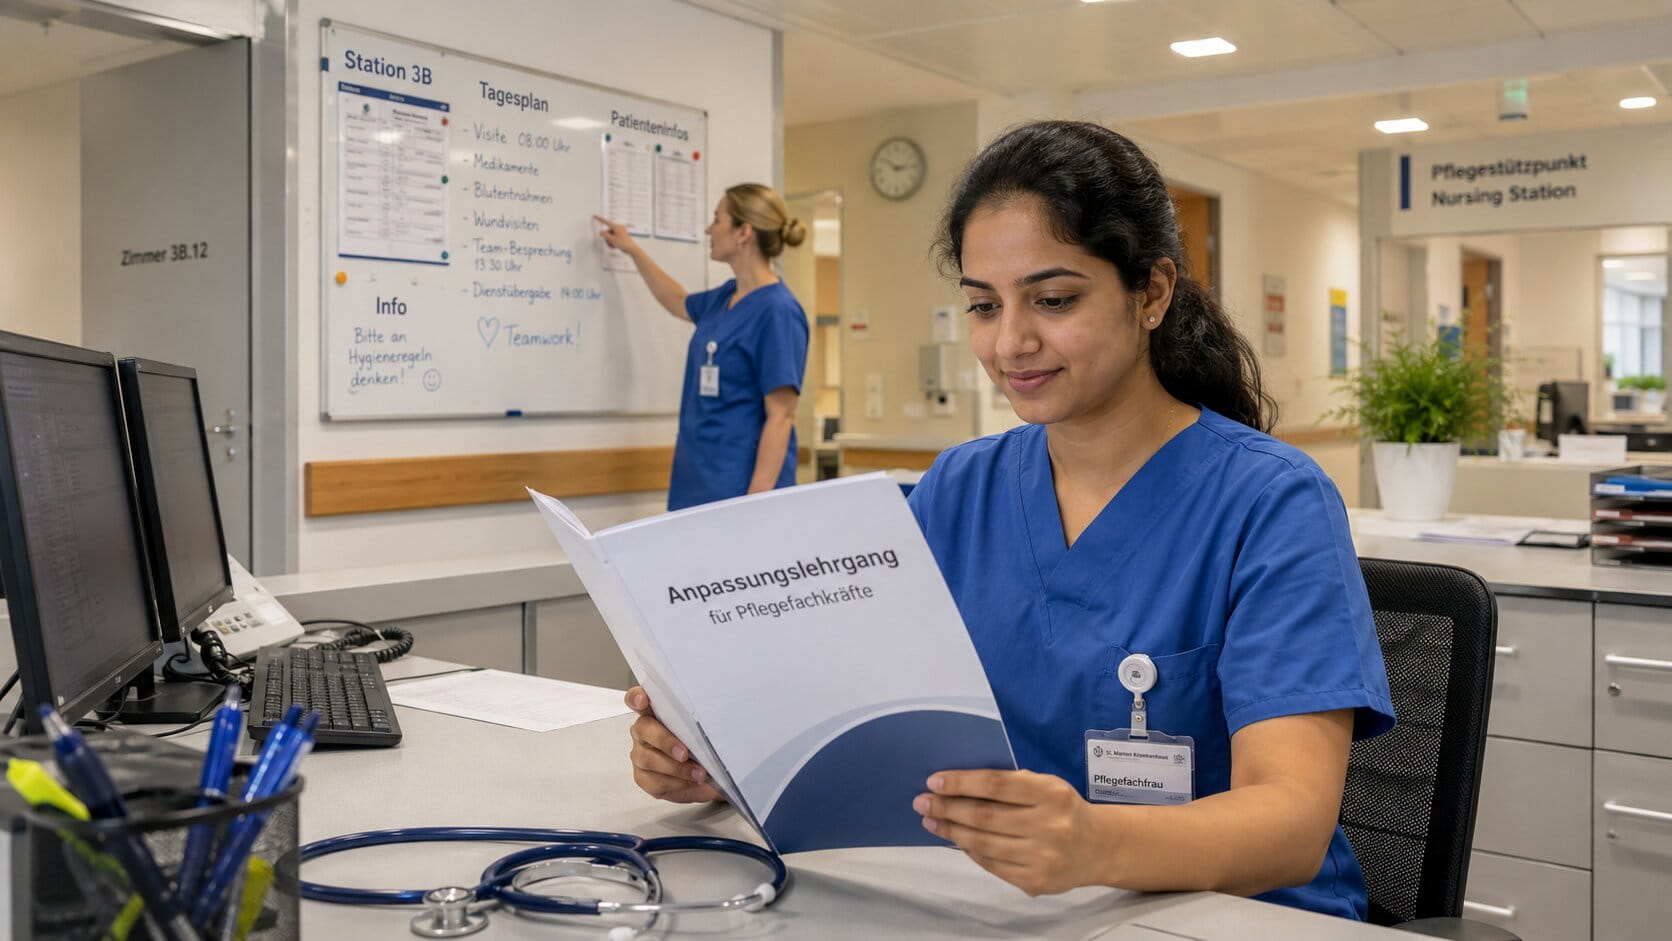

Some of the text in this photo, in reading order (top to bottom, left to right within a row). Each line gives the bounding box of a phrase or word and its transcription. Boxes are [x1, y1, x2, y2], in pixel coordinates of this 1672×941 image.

[345, 50, 432, 85] Station 3B
[480, 81, 548, 112] Tagesplan
[473, 121, 508, 144] Visite
[552, 138, 572, 153] Uhr
[611, 111, 689, 141] Patienteninfos
[473, 152, 540, 177] Medikamente
[1431, 154, 1588, 181] Pflegestützpunkt
[473, 181, 554, 204] Blutentnahmen
[1431, 182, 1576, 208] Nursing Station
[473, 209, 540, 231] Wundvisiten
[121, 241, 208, 266] Zimmer 3B.12
[473, 237, 572, 264] Team-Besprechung
[504, 259, 523, 273] Uhr
[472, 281, 552, 305] Dienstübergabe
[376, 296, 407, 316] Info
[354, 326, 407, 344] Bitte an
[348, 346, 433, 371] Hygieneregeln
[667, 549, 900, 605] Anpassungslehrgang
[709, 585, 875, 625] für Pflegefachkräfte
[1094, 774, 1164, 789] Pflegefachfrau
